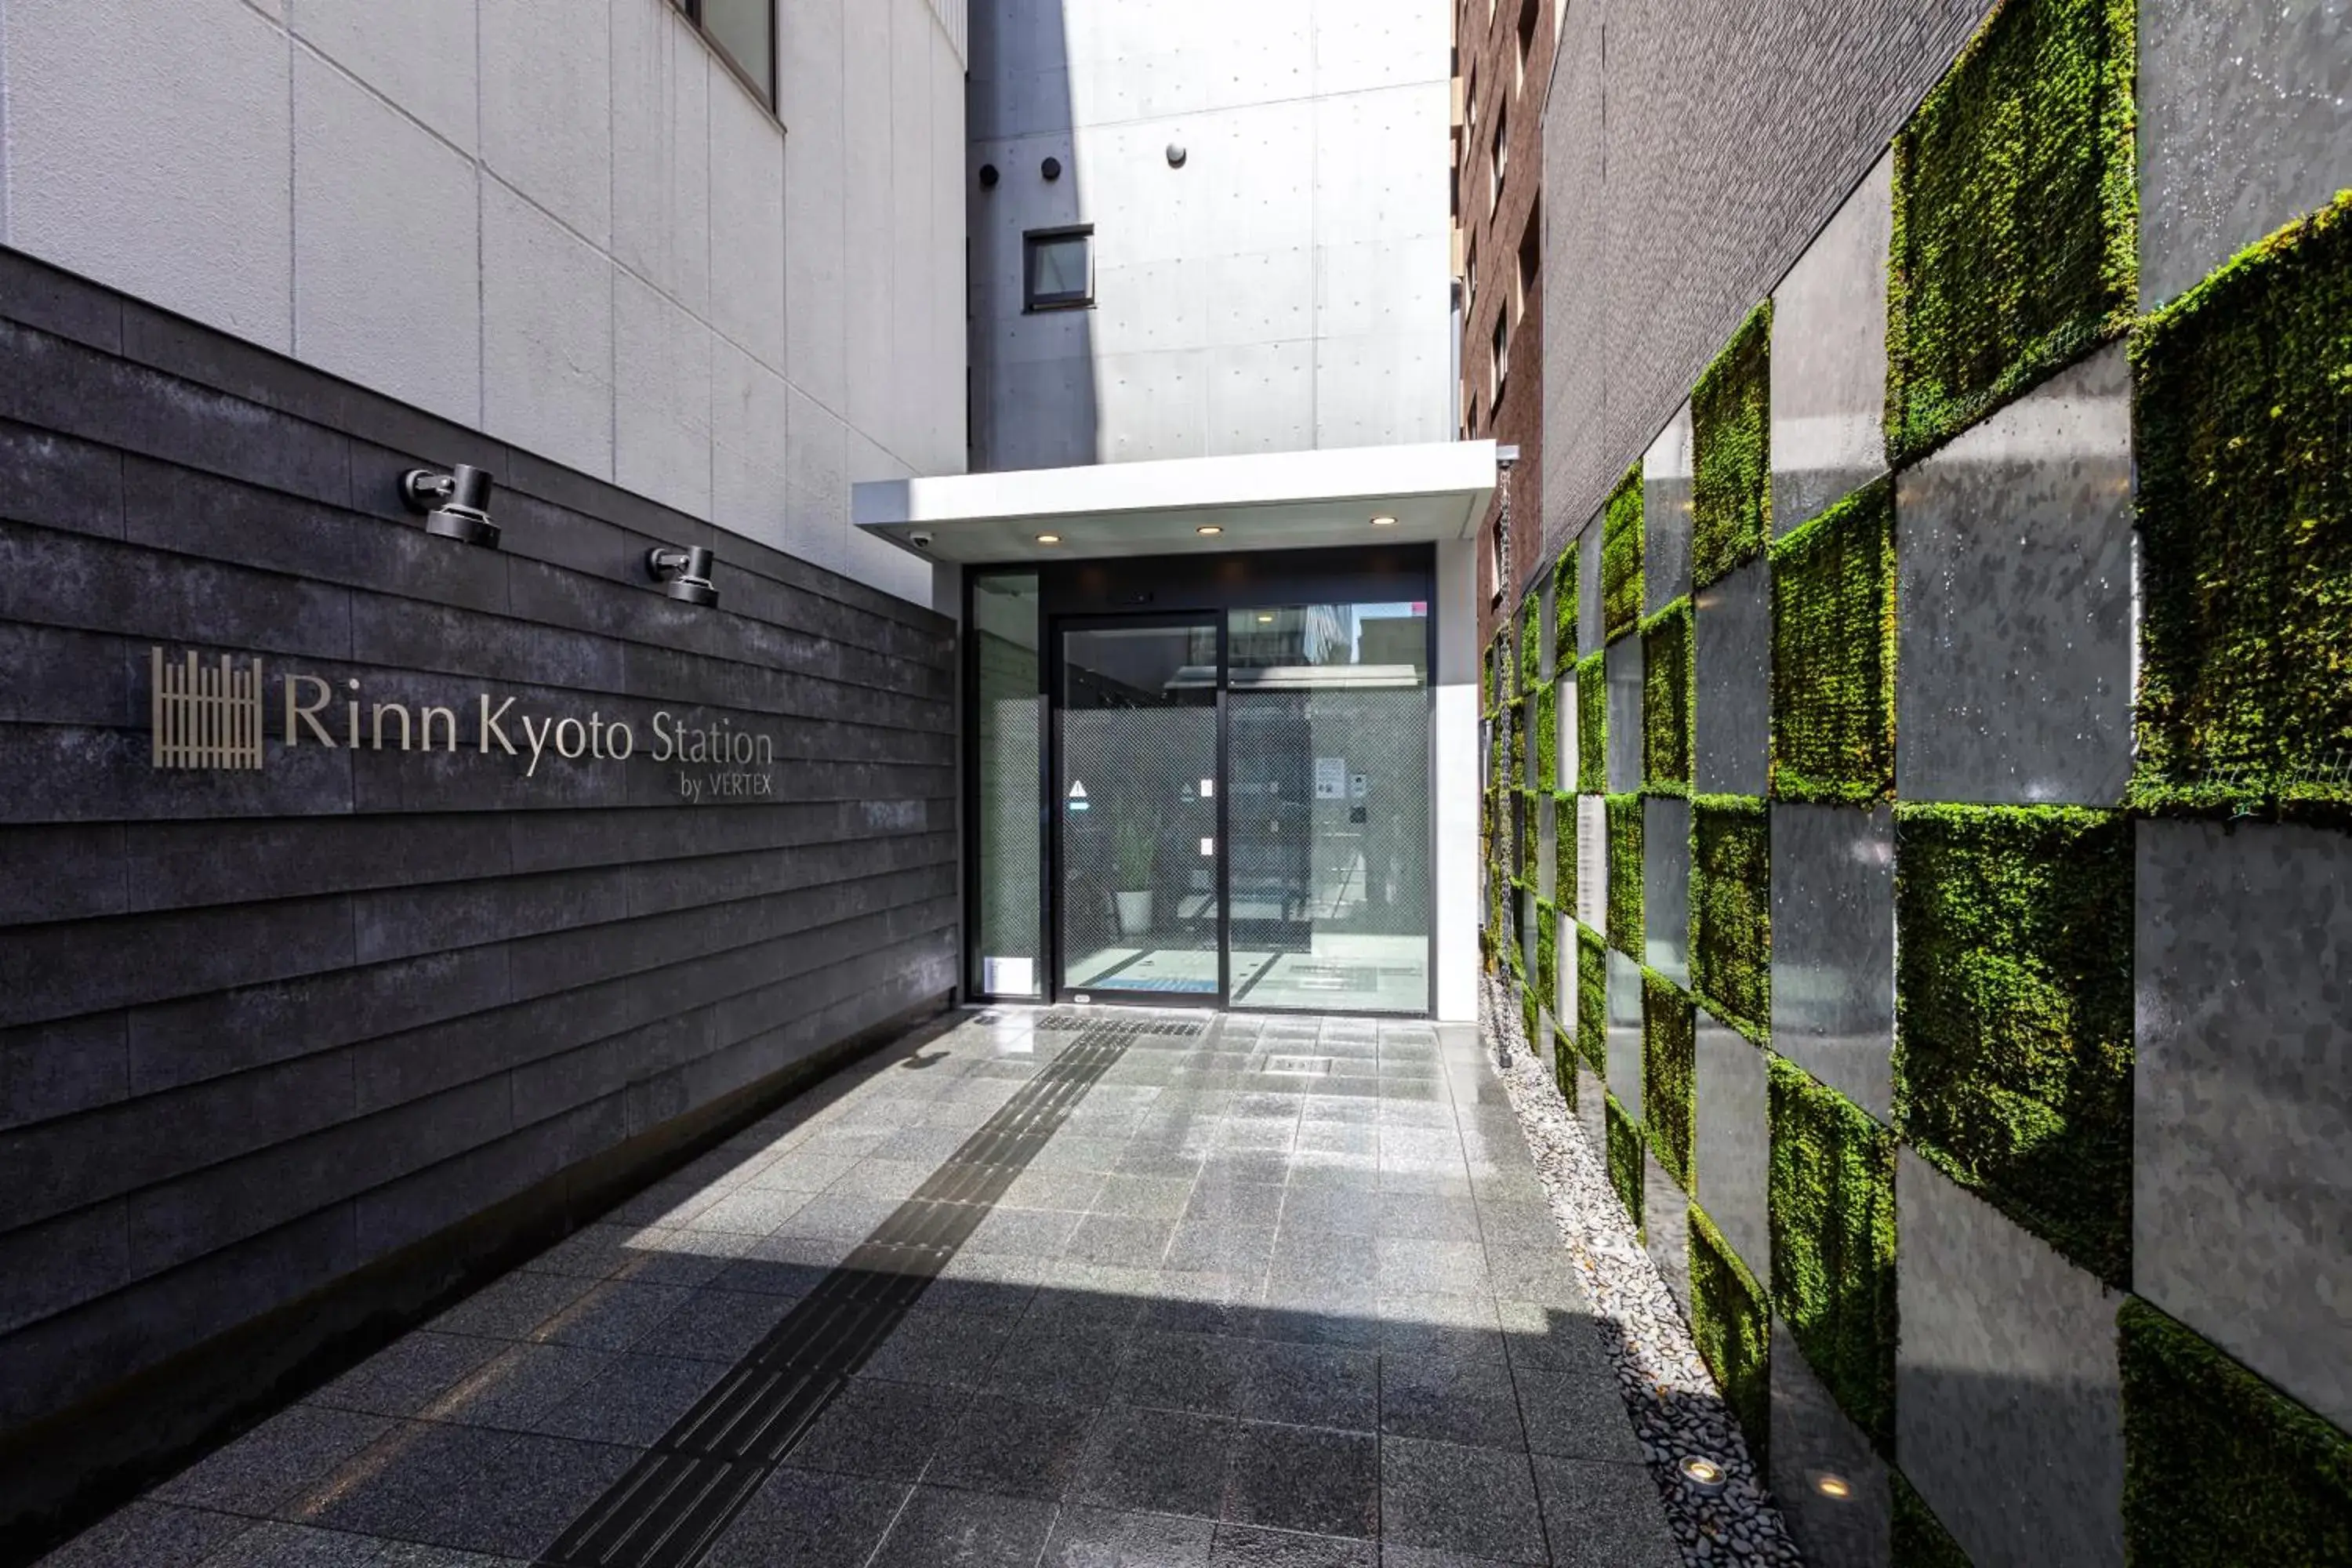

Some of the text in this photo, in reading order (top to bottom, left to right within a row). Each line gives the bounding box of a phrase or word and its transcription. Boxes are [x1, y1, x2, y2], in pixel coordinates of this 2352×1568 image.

[285, 673, 772, 777] Rinn Kyoto Station
[680, 771, 771, 803] by VERTEX
